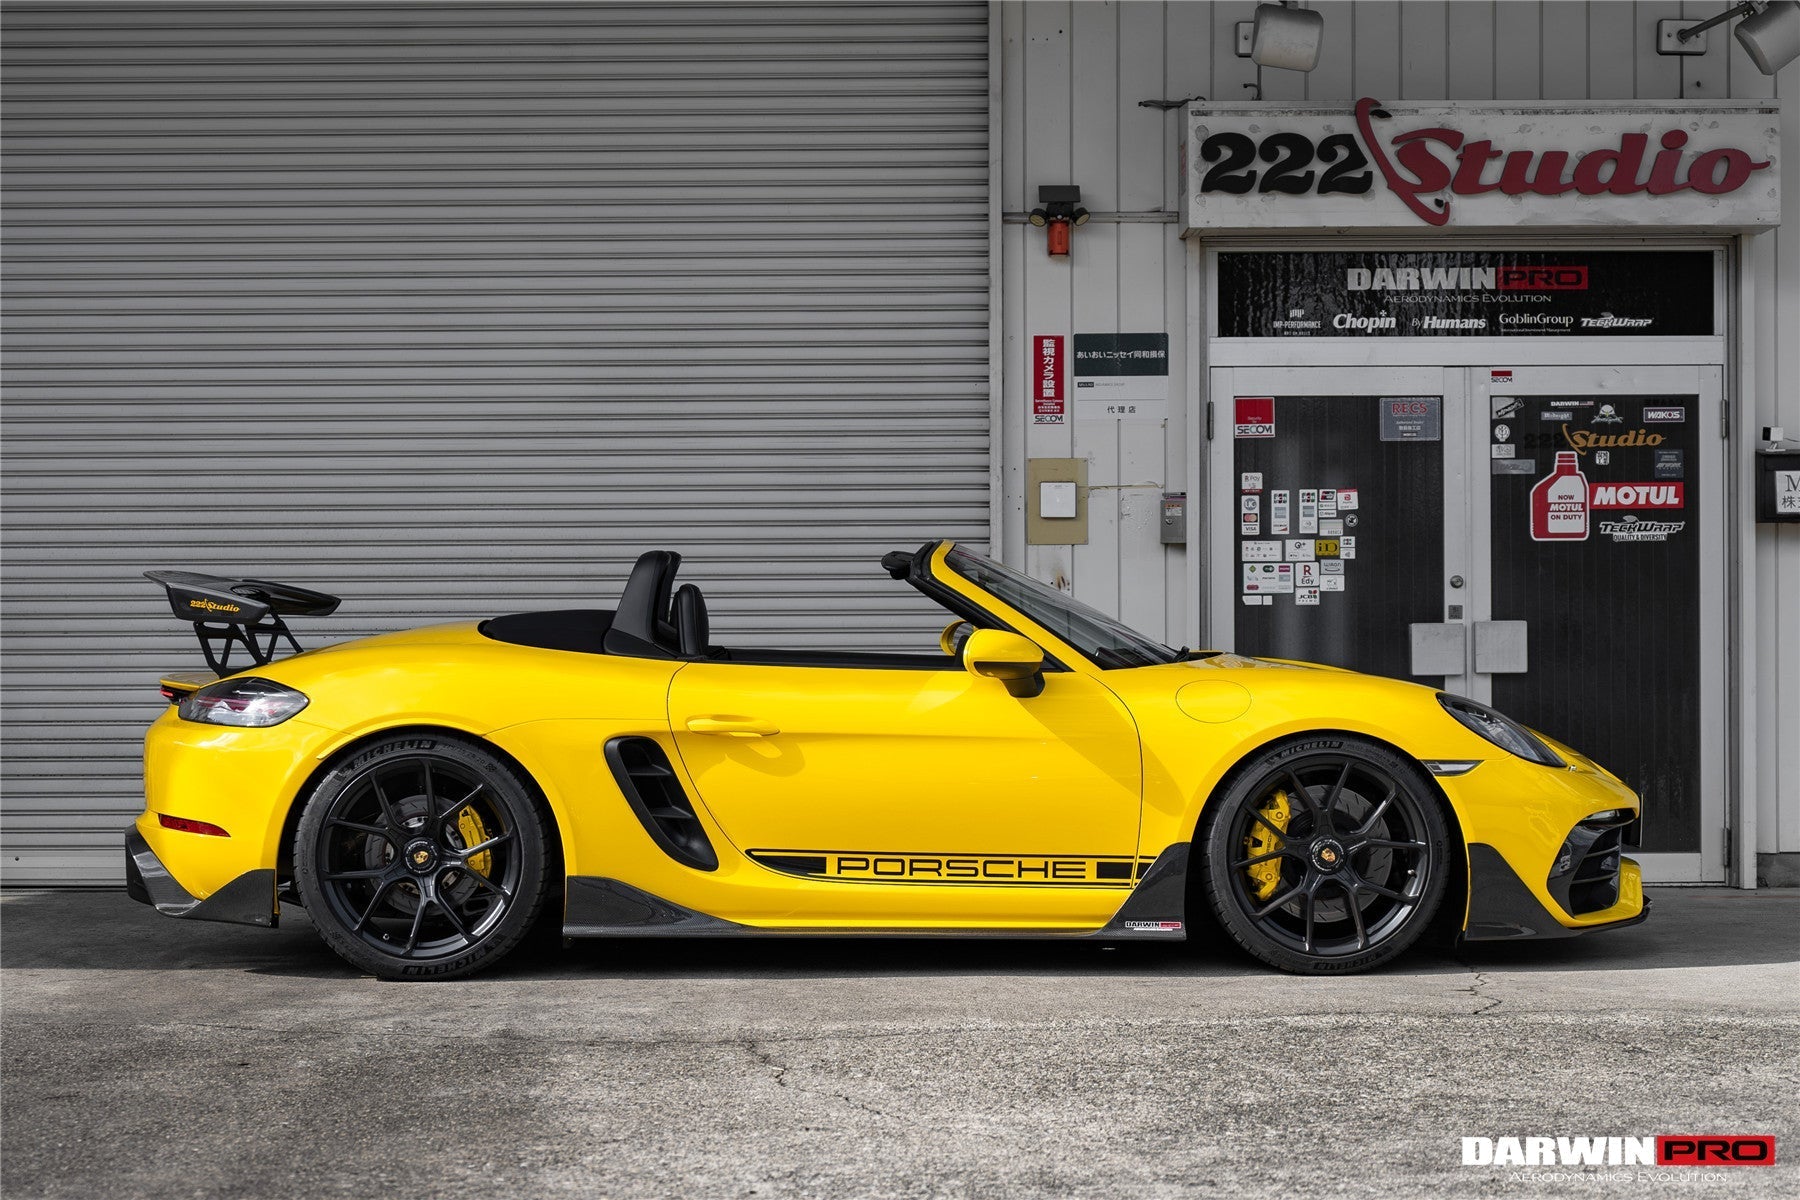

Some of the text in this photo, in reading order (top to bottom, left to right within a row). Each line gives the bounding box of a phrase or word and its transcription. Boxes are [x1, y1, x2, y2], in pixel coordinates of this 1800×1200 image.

[1201, 104, 1771, 216] 222 Studio
[1347, 267, 1583, 290] DARWIN PRO
[1384, 294, 1552, 303] AERODYNAMICS EVOLUTION
[1333, 311, 1397, 333] Chopin
[1411, 316, 1487, 329] By Humans
[1499, 312, 1574, 327] GoblinGroup
[1076, 350, 1166, 360] あいおいニッセイ同和損保
[1042, 338, 1056, 398] 監視カメラ設置
[1107, 405, 1137, 414] 代理店
[1392, 402, 1429, 414] RECS
[1034, 414, 1064, 423] SECOM
[1236, 425, 1273, 434] SECOM
[1563, 425, 1667, 453] Studio
[1593, 486, 1680, 505] MOTUL
[1550, 503, 1584, 512] MOTUL
[1318, 542, 1338, 552] iD
[1303, 564, 1312, 576] R
[1301, 577, 1315, 585] Edy
[205, 601, 240, 612] Studio
[353, 739, 433, 769] MICHELIN
[1280, 741, 1341, 758] MICHELIN
[837, 856, 1086, 878] PORSCHE
